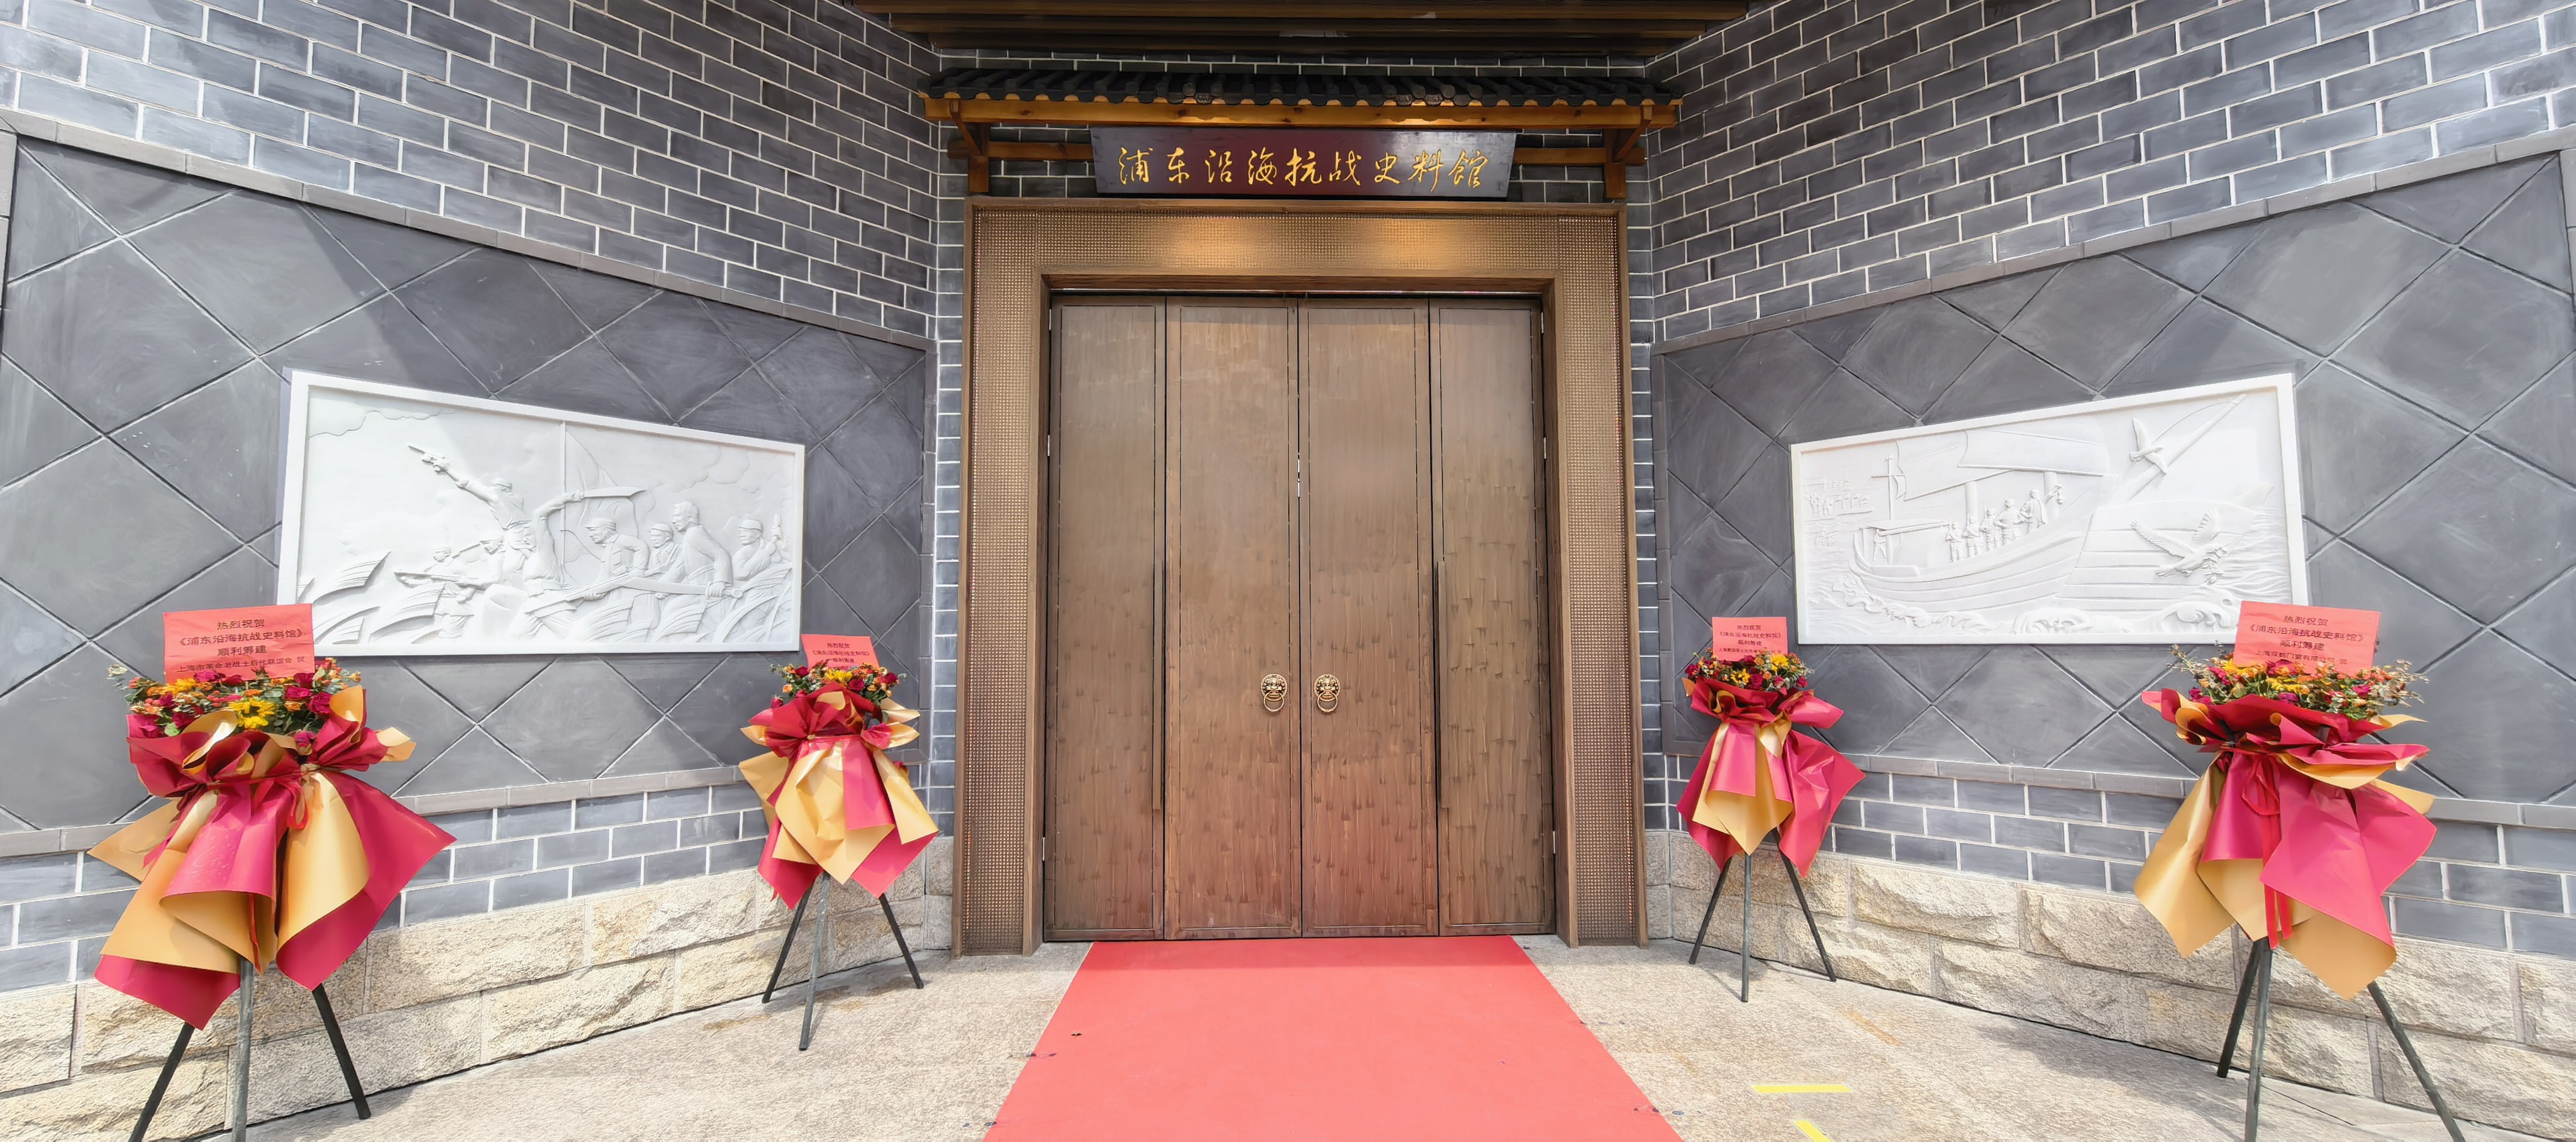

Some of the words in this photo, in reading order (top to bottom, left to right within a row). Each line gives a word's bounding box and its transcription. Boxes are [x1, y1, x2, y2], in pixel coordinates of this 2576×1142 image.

[1119, 147, 1488, 192] 浦东沿海抗战史料馆
[217, 619, 265, 629] 热烈祝贺
[2283, 615, 2328, 626] 热烈祝贺
[179, 629, 303, 646] 《浦东沿海抗战史料馆》
[2250, 624, 2364, 642] 《浦东沿海抗战史料馆》
[217, 645, 267, 657] 顺利筹建
[2280, 640, 2325, 651] 顺利筹建
